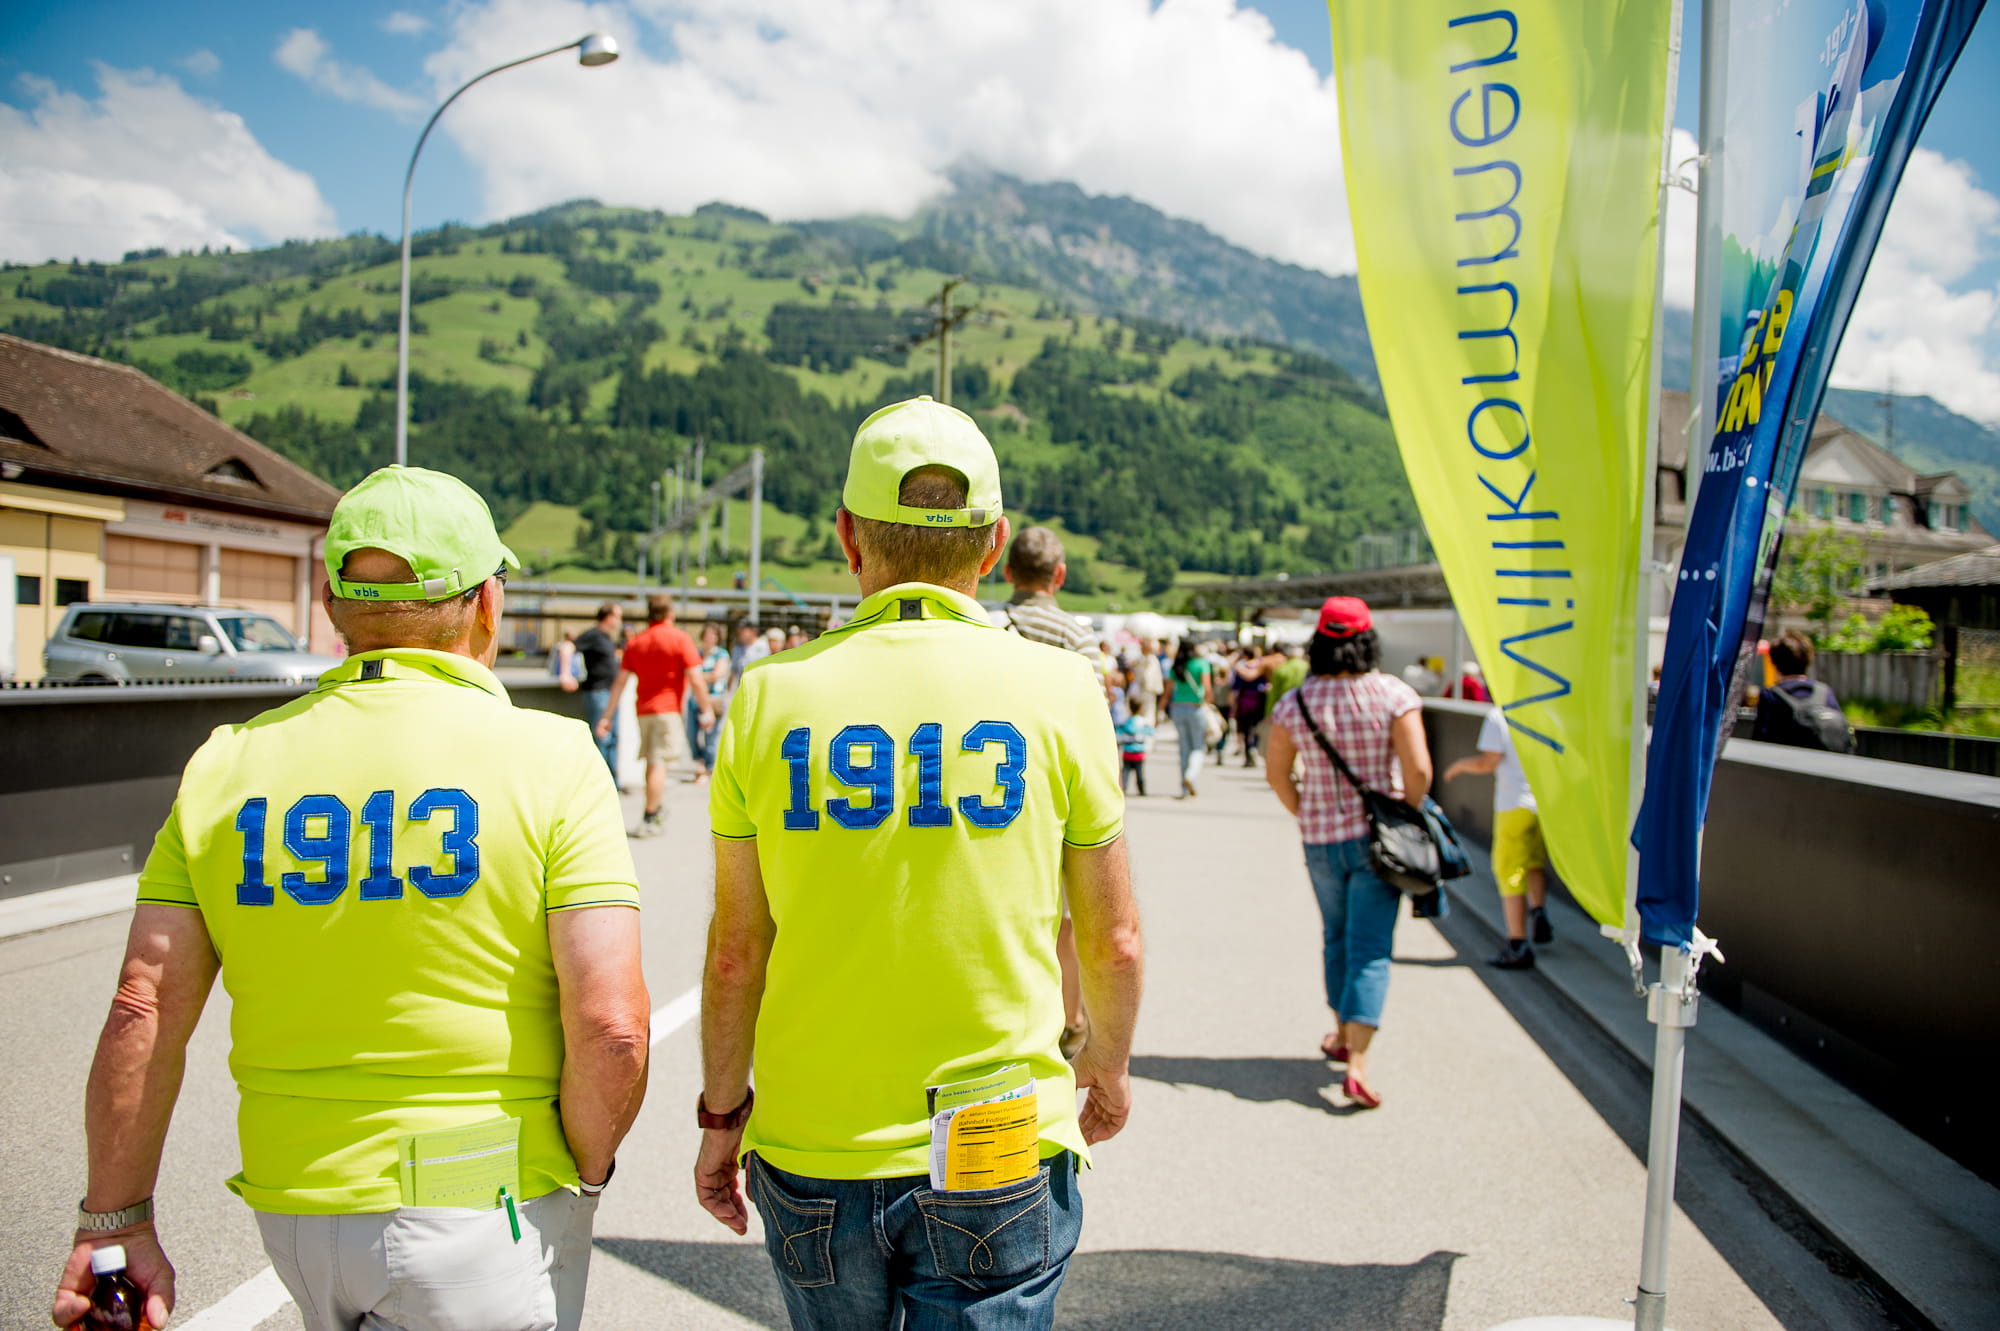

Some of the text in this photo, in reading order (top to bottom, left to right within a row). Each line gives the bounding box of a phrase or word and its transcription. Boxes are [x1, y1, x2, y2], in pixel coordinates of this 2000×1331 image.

[1448, 8, 1575, 754] Willkommen
[935, 514, 953, 523] bls
[362, 587, 380, 597] bls
[781, 720, 1027, 831] 1913
[235, 788, 480, 906] 1913
